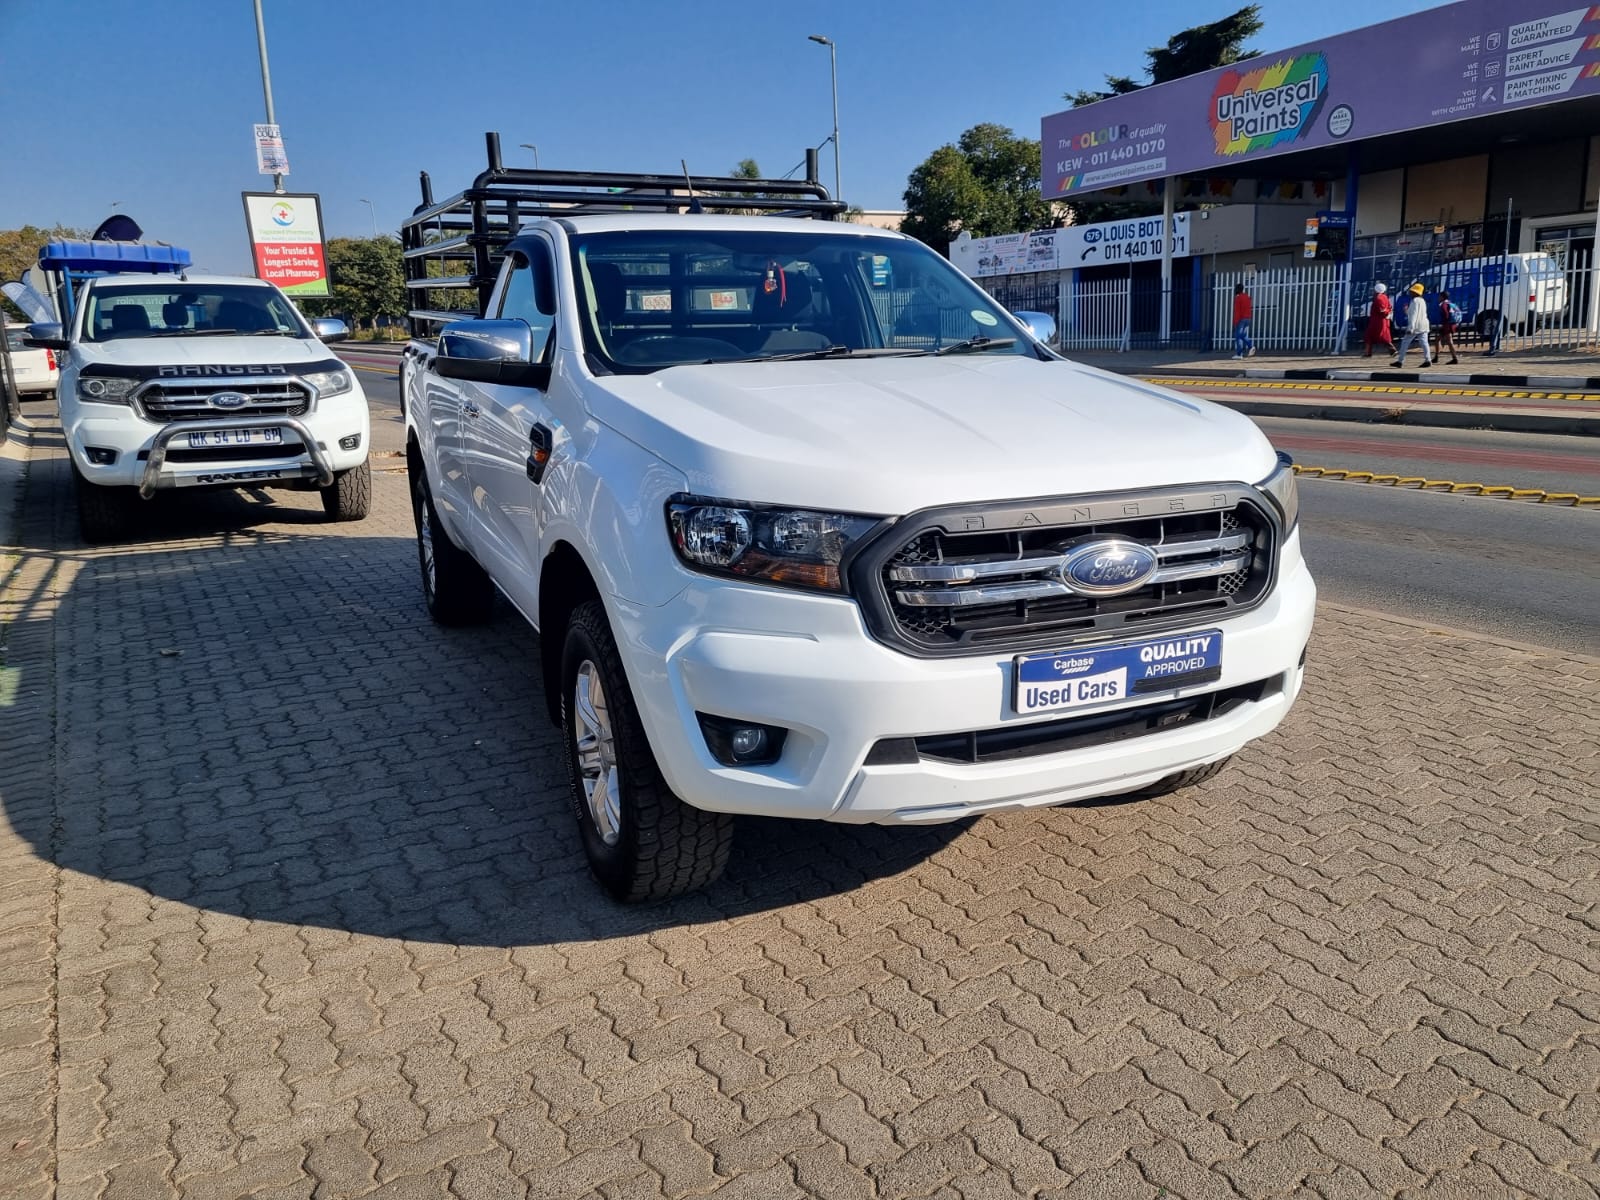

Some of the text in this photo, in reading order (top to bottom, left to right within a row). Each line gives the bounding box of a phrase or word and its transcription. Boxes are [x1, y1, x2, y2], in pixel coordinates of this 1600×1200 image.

[1510, 21, 1550, 37] QUALITY
[1510, 25, 1573, 45] GUARANTEED
[1460, 42, 1480, 52] MAKE
[1469, 36, 1480, 44] WE
[1508, 53, 1571, 73] PAINT ADVICE
[1509, 50, 1544, 64] EXPERT
[1468, 62, 1478, 70] WE
[1507, 72, 1568, 91] PAINT MIXING
[1218, 75, 1318, 119] Universal
[1456, 96, 1476, 104] PAINT
[1463, 89, 1477, 97] YOU
[1506, 83, 1561, 100] & MATCHING
[1448, 102, 1476, 113] QUALITY
[1233, 108, 1299, 138] Paints
[1058, 122, 1168, 151] The COLOUR of quality
[1057, 156, 1083, 174] KEW
[1091, 151, 1108, 166] 011
[1110, 146, 1134, 160] 440
[1135, 138, 1166, 156] 1070
[1103, 223, 1136, 242] LOUIS
[264, 246, 314, 255] Your Trusted &
[1104, 243, 1122, 260] 011
[1124, 240, 1148, 258] 440
[264, 258, 320, 268] Longest Serving
[266, 268, 320, 278] Local Pharmacy
[158, 364, 287, 376] RANGER
[218, 395, 240, 406] Ford
[192, 427, 280, 446] MK 54 LD GP
[197, 470, 282, 483] RANGER
[964, 494, 1228, 530] RANGER
[1088, 556, 1140, 582] Ford
[1140, 636, 1212, 663] QUALITY
[1054, 656, 1094, 671] Carbase
[1145, 656, 1206, 678] APPROVED
[1026, 680, 1118, 709] Used Cars
